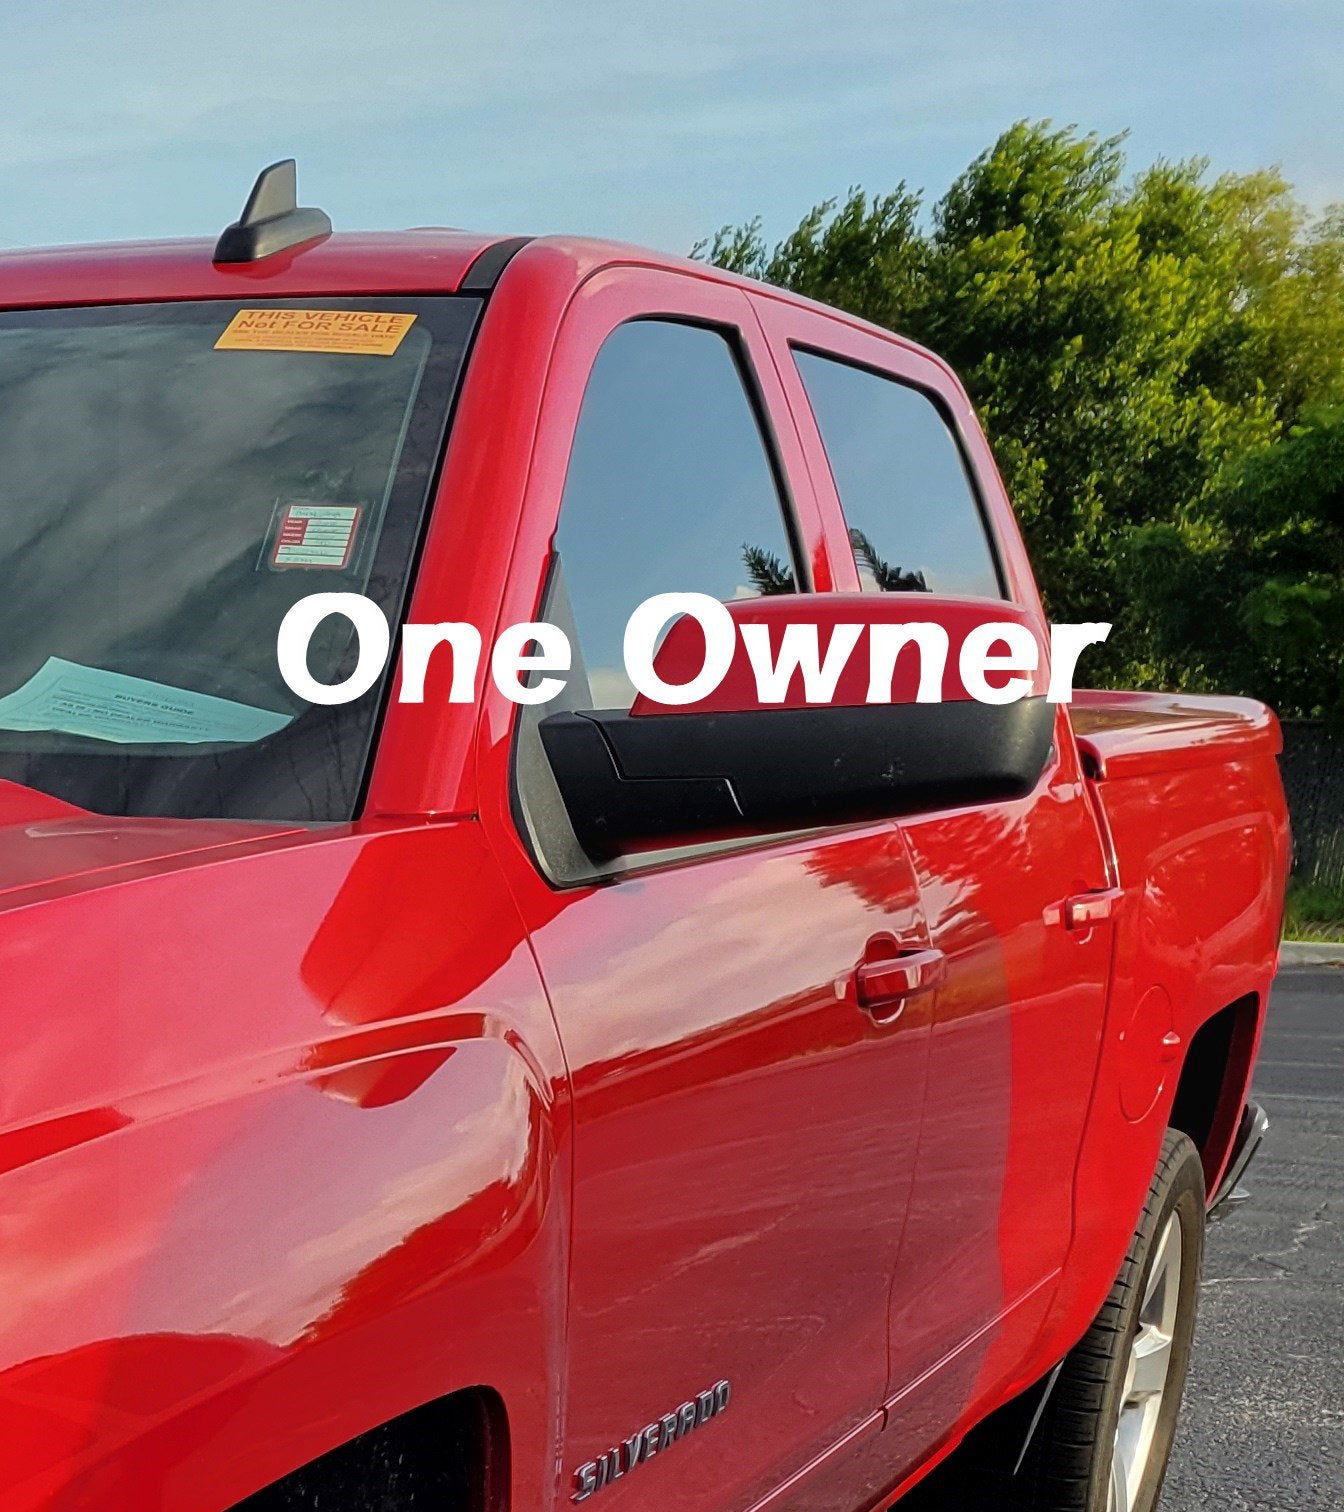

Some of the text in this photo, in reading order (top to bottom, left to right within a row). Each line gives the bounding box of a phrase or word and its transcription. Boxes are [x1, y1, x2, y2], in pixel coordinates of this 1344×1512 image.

[246, 311, 406, 324] THIS VEHICLE
[238, 320, 277, 329] Not
[283, 321, 332, 331] FOR
[338, 323, 404, 334] SALE
[569, 1379, 731, 1505] SILVERADO
